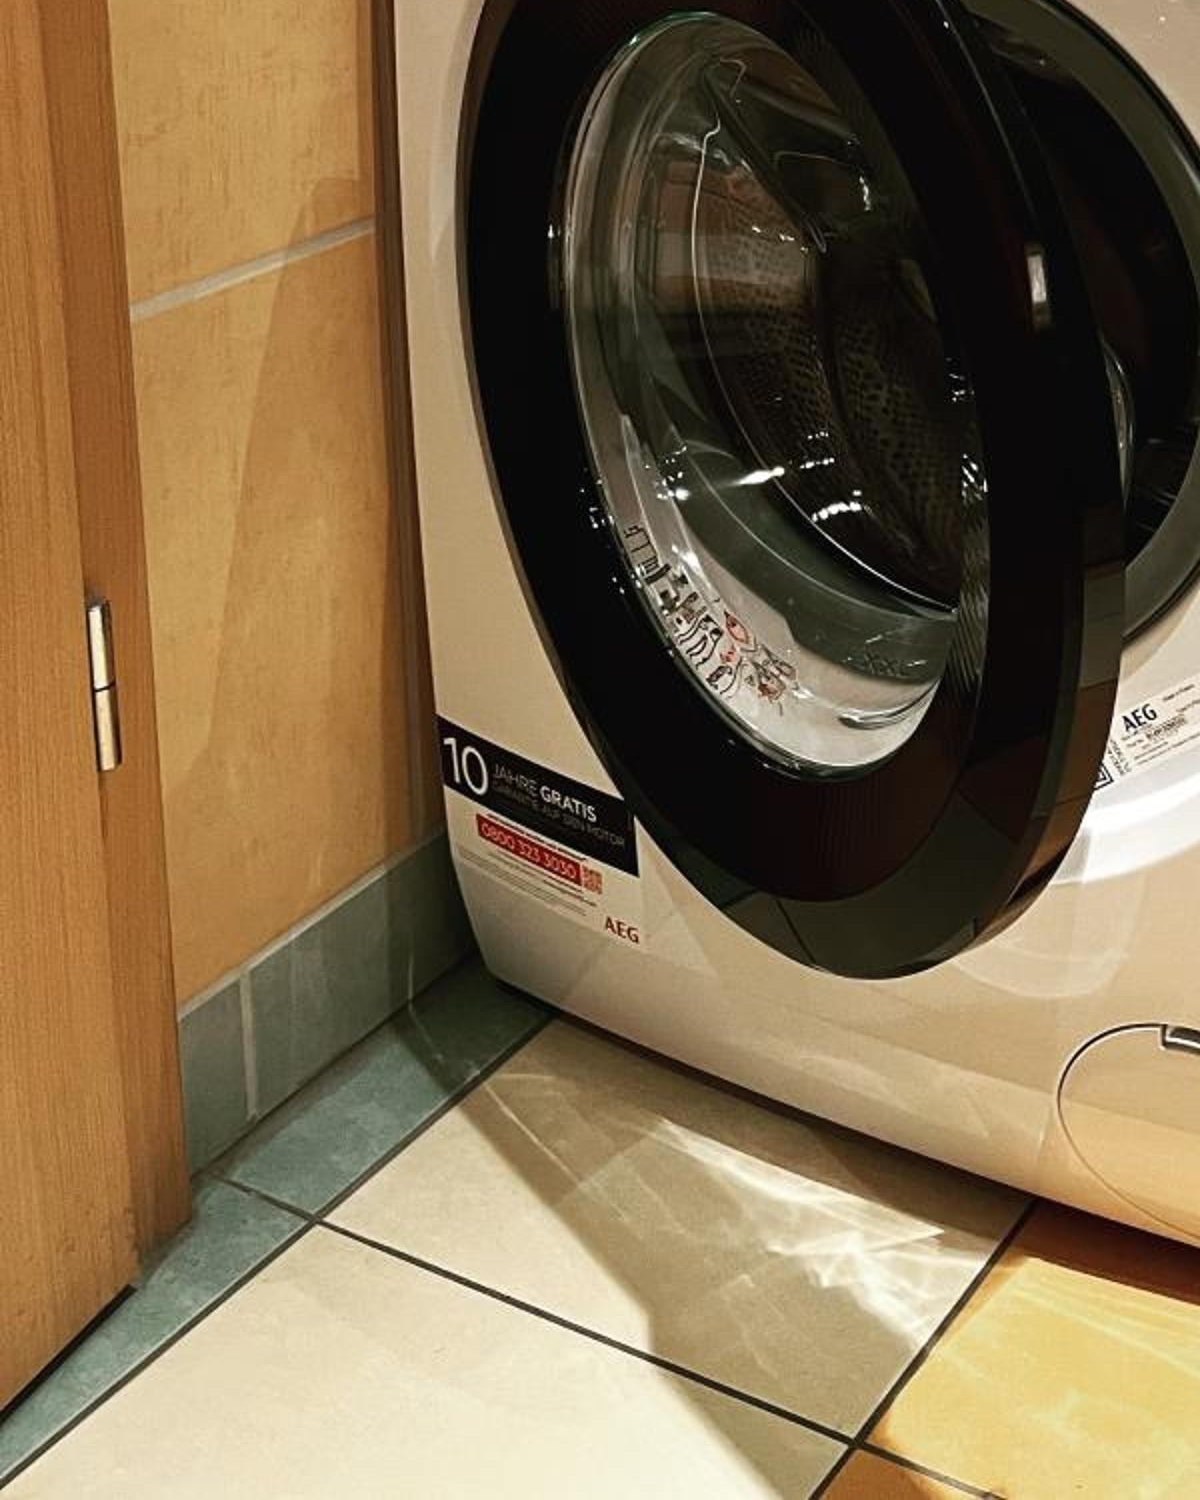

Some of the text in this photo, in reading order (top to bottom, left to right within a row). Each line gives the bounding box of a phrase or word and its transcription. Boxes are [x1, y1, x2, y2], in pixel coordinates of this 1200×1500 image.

[1121, 703, 1158, 733] AEG
[443, 737, 598, 824] 10 JAHRE GRATIS
[604, 915, 640, 945] AEG
